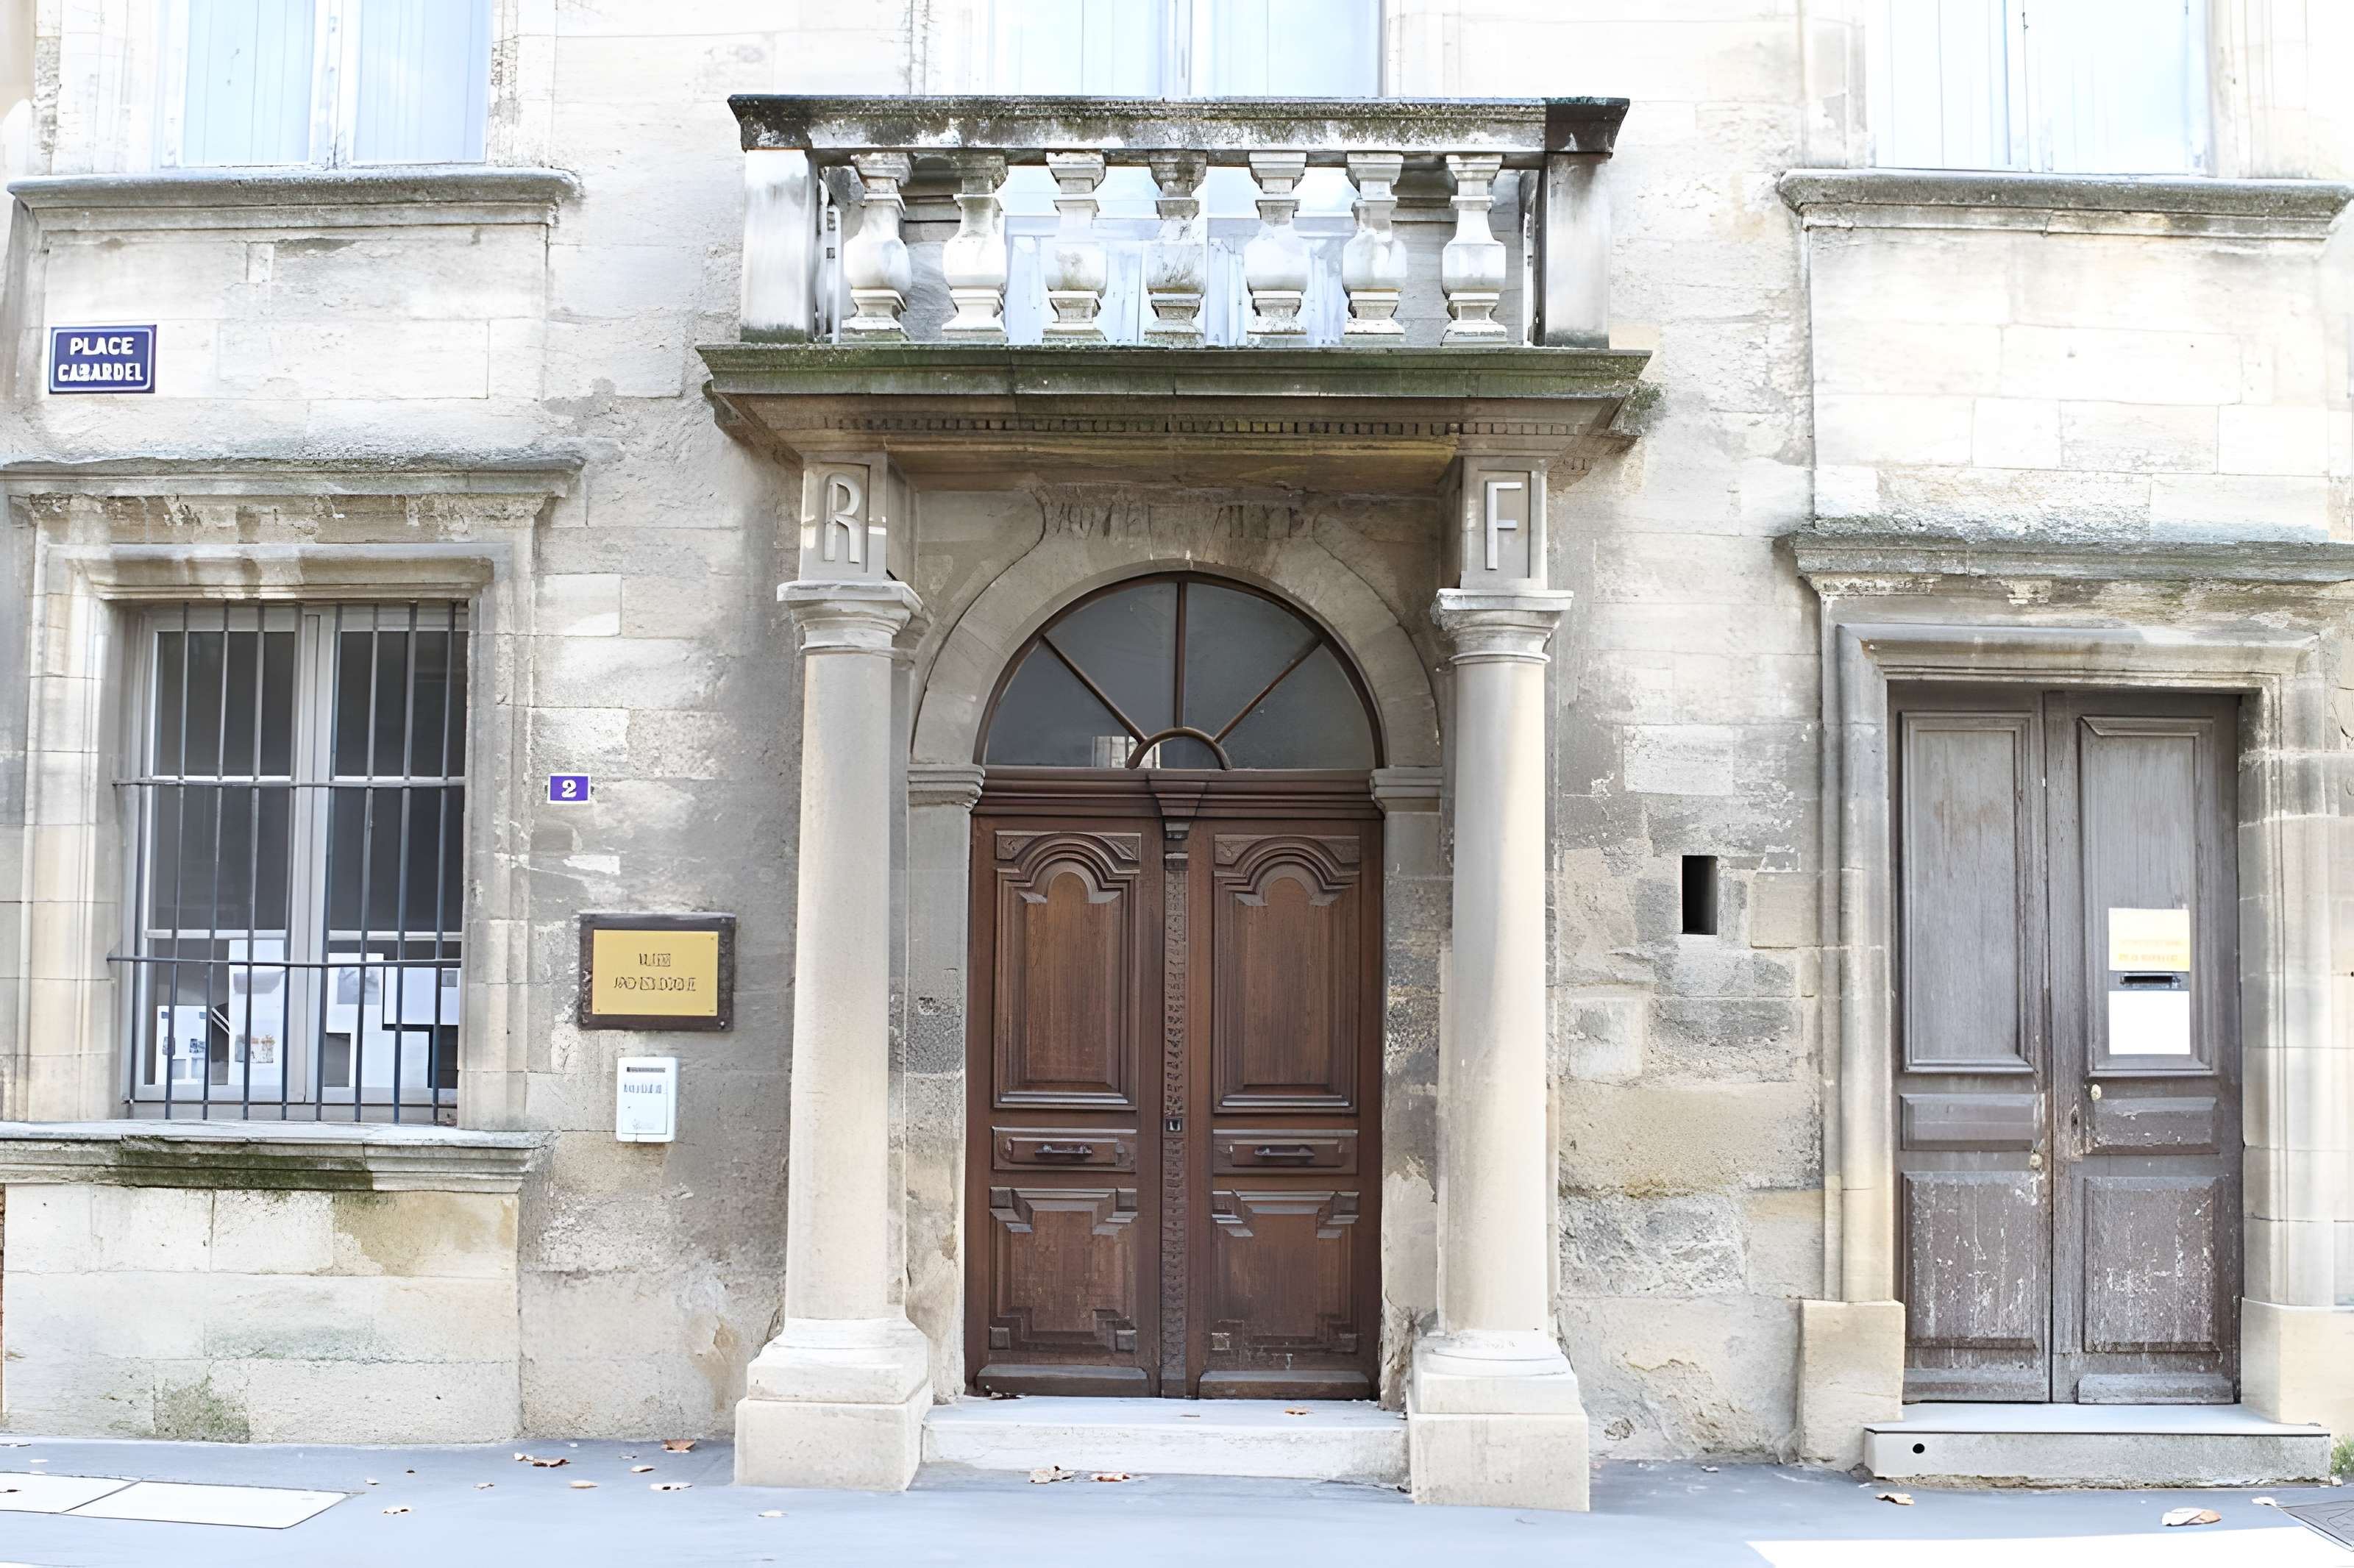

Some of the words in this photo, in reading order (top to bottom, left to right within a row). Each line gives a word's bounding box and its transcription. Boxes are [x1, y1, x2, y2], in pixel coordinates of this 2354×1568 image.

[70, 337, 135, 355] PLACE
[57, 363, 143, 382] CABARDEL
[824, 473, 861, 563] R
[1485, 481, 1522, 570] F
[561, 780, 577, 797] 2
